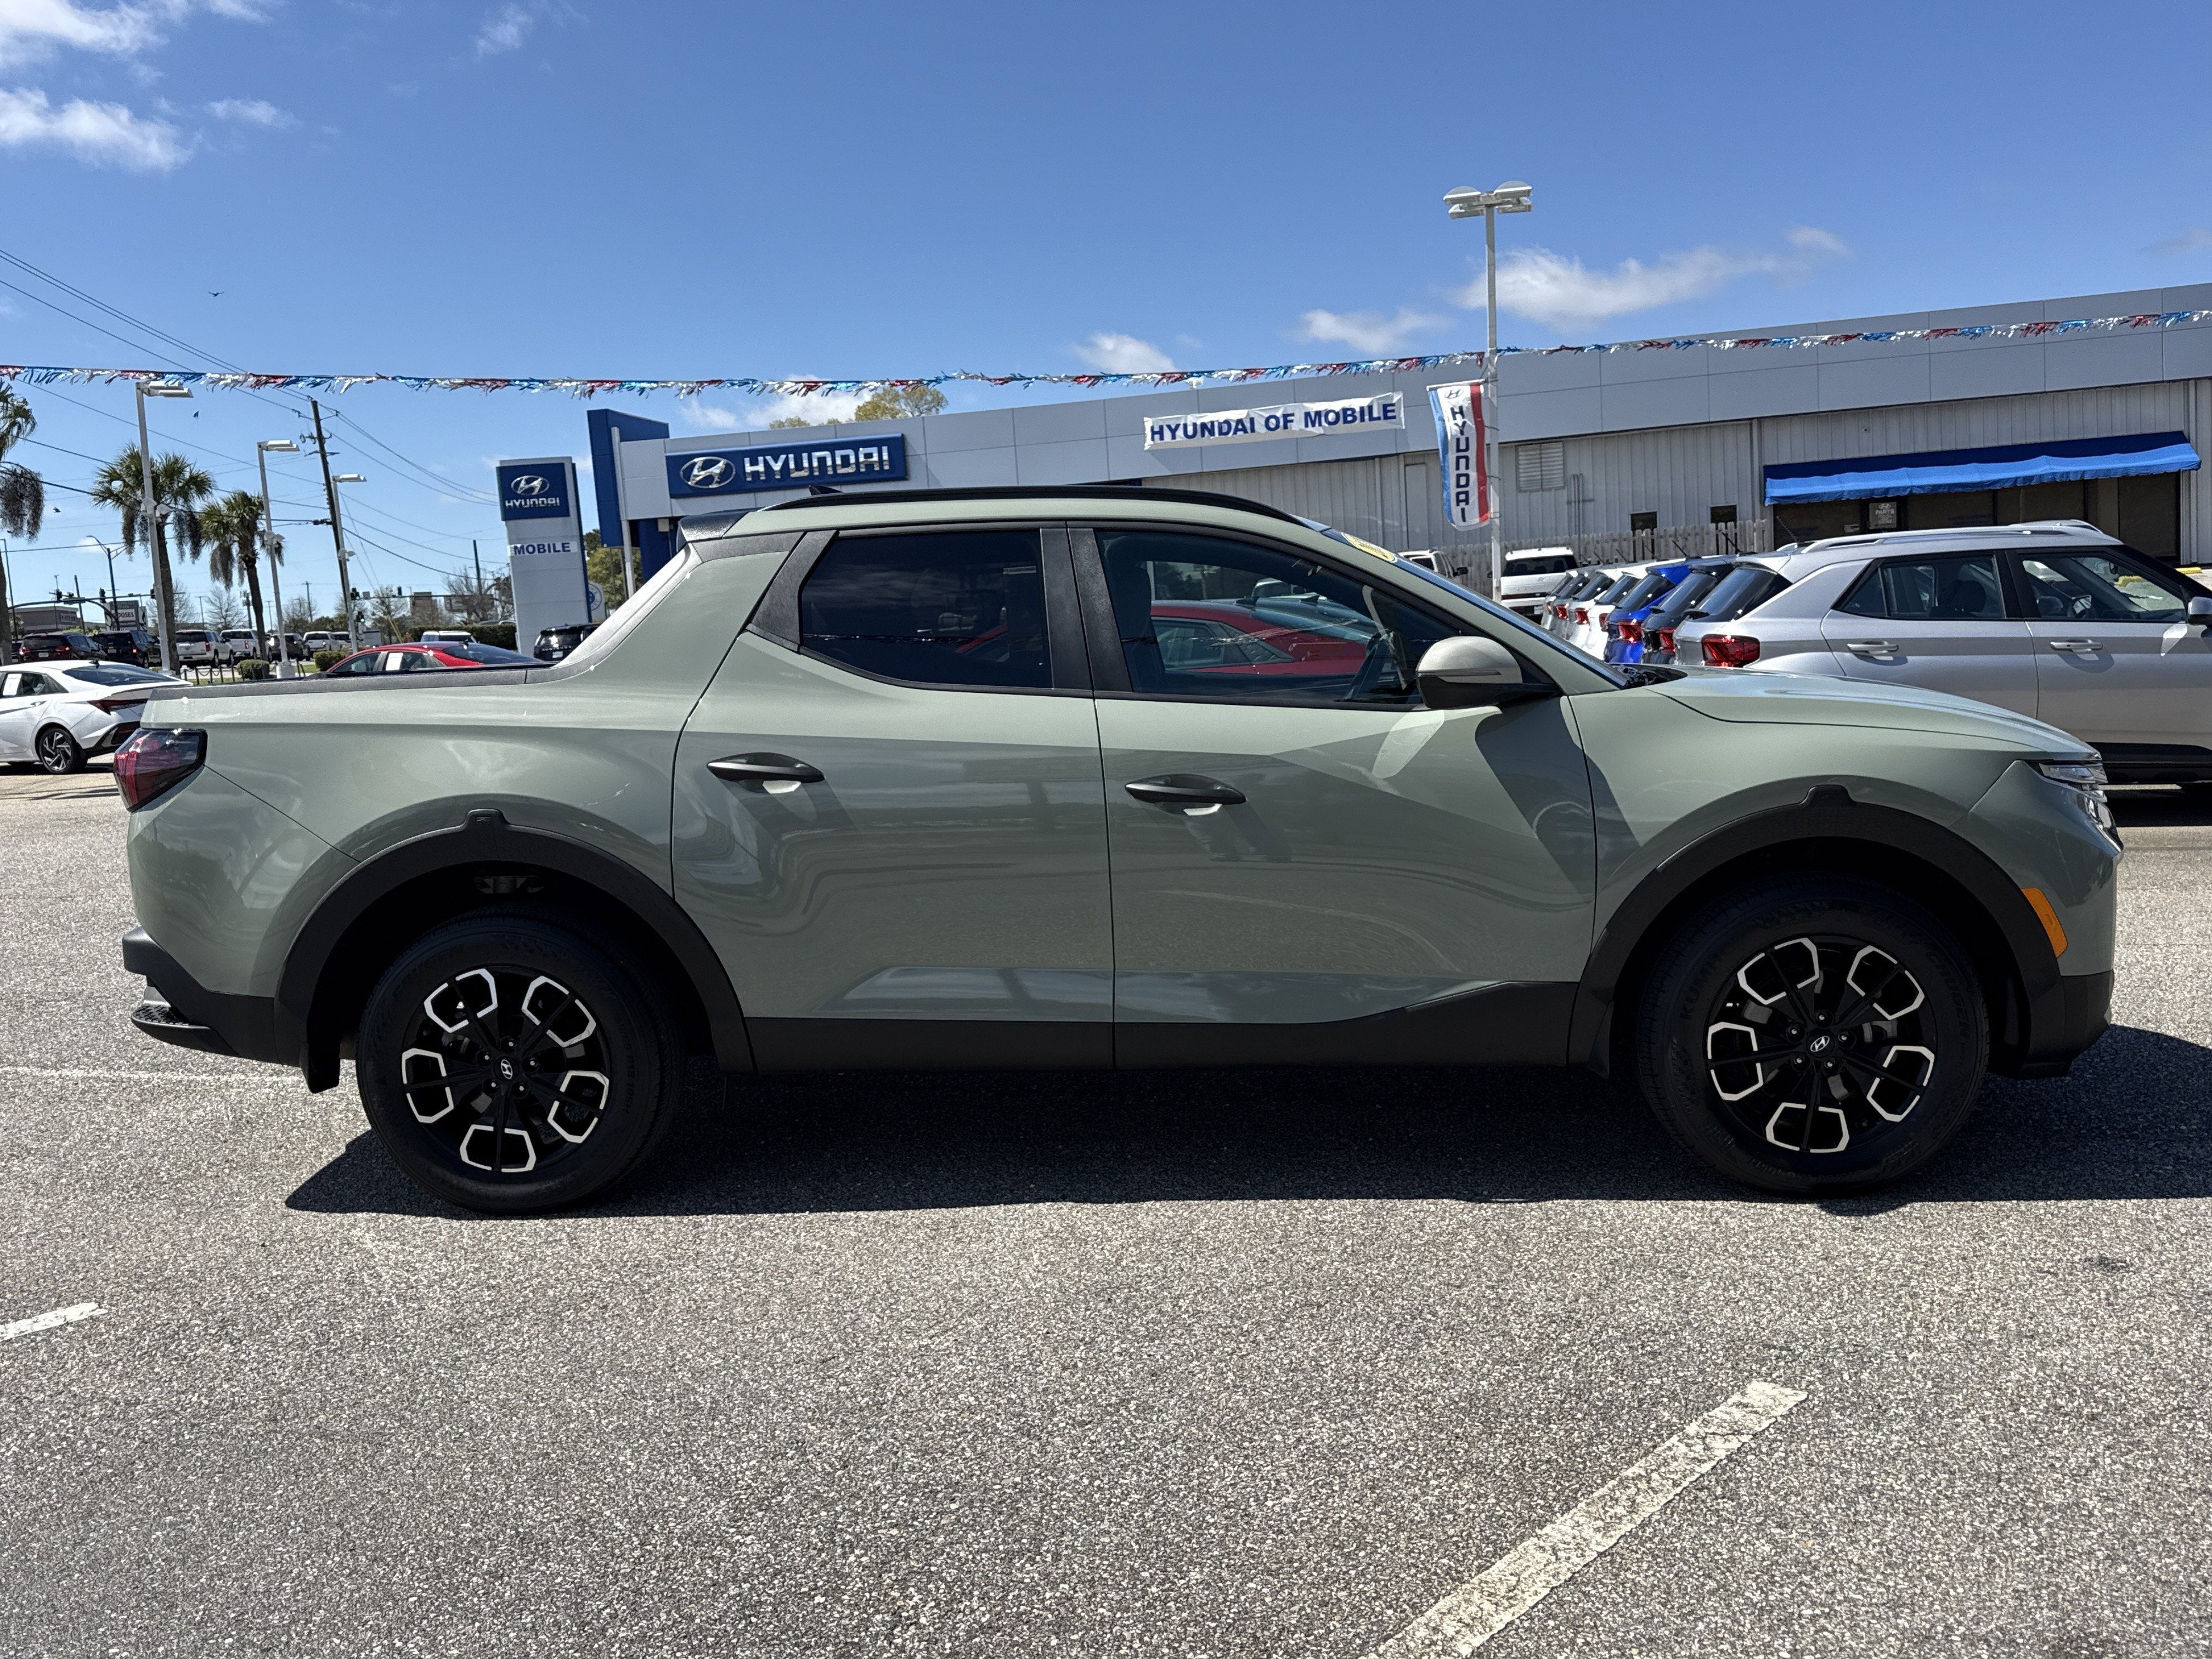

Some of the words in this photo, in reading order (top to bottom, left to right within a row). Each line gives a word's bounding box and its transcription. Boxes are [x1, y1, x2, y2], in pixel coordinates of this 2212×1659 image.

[1150, 419, 1255, 442] HYUNDAI
[1265, 413, 1295, 432] OF
[1304, 403, 1397, 428] MOBILE
[743, 445, 890, 481] HYUNDAI
[1450, 405, 1470, 522] HYUNDAI
[505, 497, 560, 509] HYUNDAI
[513, 543, 571, 555] MOBILE
